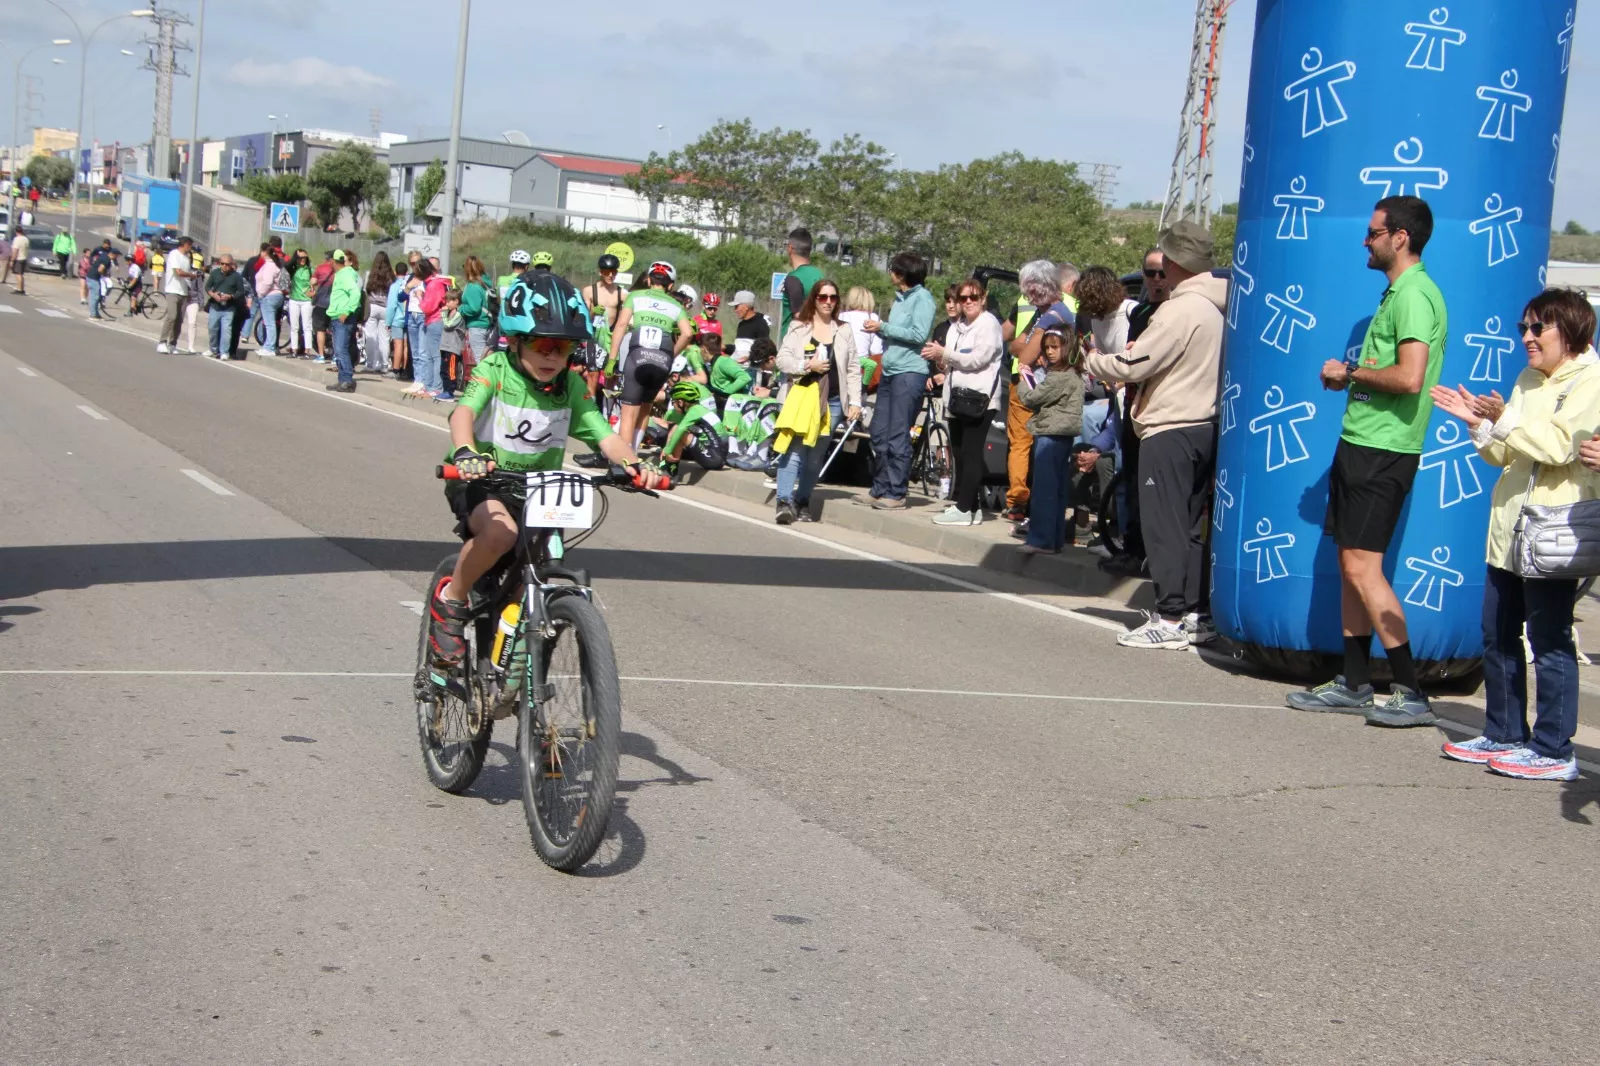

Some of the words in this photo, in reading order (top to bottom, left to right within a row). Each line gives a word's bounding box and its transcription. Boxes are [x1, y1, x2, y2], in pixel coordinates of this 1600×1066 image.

[645, 328, 657, 341] 17
[537, 472, 584, 507] 170
[500, 637, 512, 665] GARMIN
